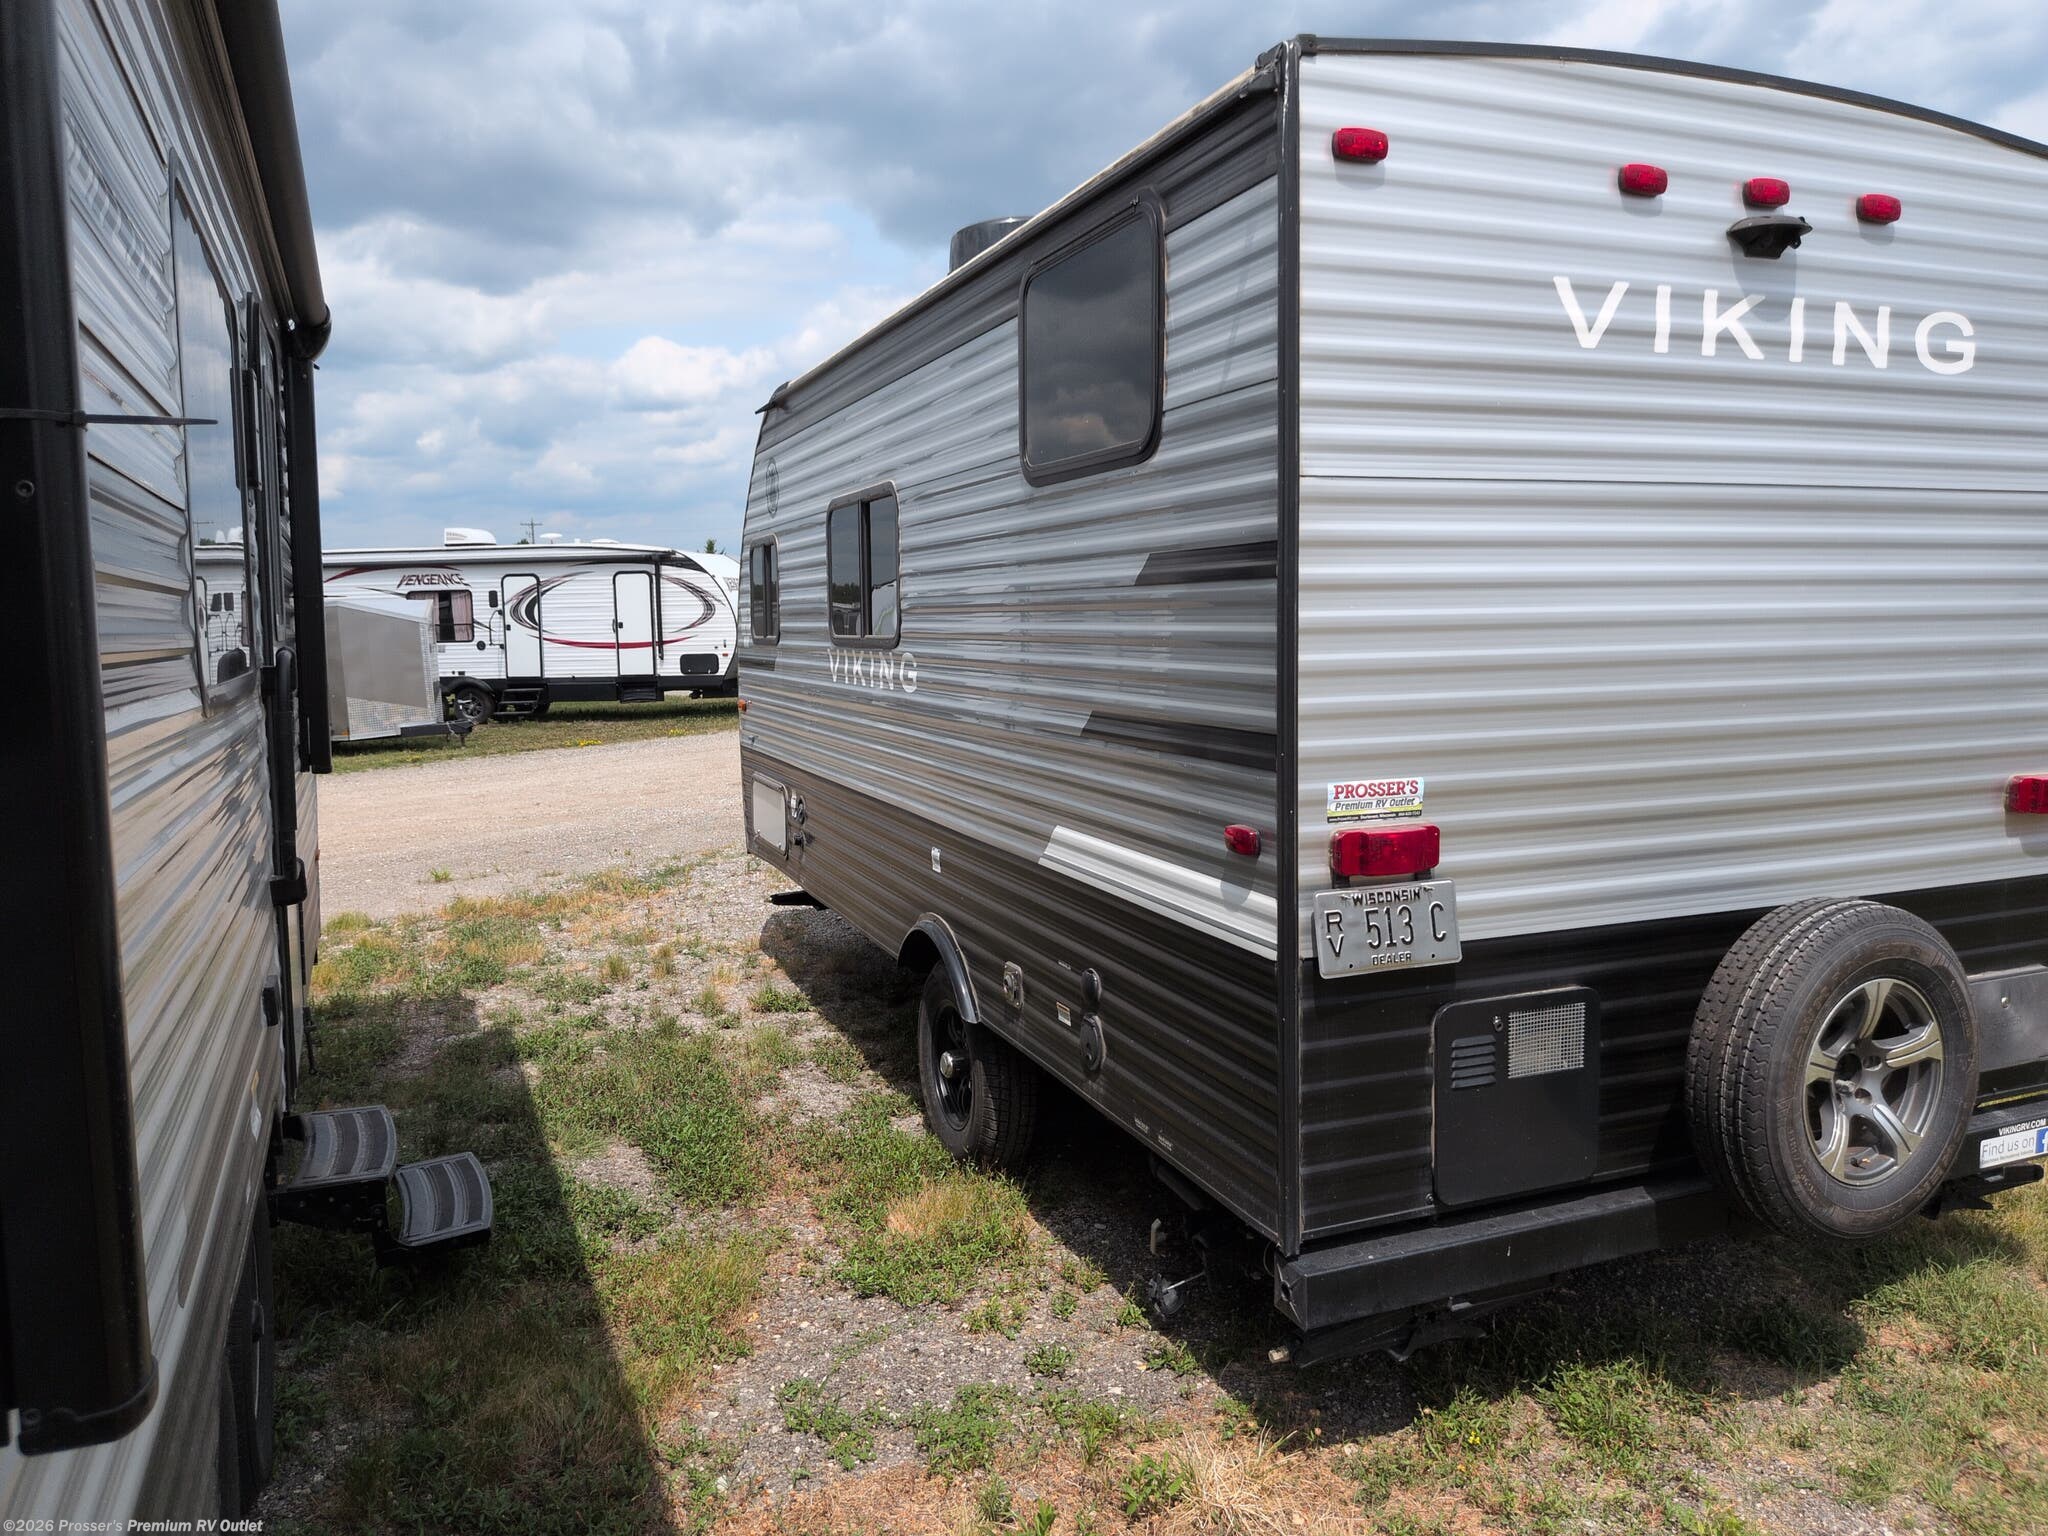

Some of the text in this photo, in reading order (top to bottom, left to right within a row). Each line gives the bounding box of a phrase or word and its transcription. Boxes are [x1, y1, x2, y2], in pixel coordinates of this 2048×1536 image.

[1553, 276, 1976, 375] VIKING
[397, 574, 472, 589] VENGEANCE
[827, 648, 918, 693] VIKING
[1333, 779, 1419, 799] PROSSER'S
[1334, 797, 1415, 811] Premium RV Outlet
[1352, 888, 1421, 906] WISCONSIN
[1364, 905, 1414, 950] 513
[1428, 901, 1447, 942] C
[1372, 953, 1412, 966] DEALER
[1999, 1118, 2046, 1136] VIKINGRV.COM
[1982, 1140, 2005, 1158] Find
[2008, 1140, 2019, 1152] us
[2022, 1136, 2035, 1149] on
